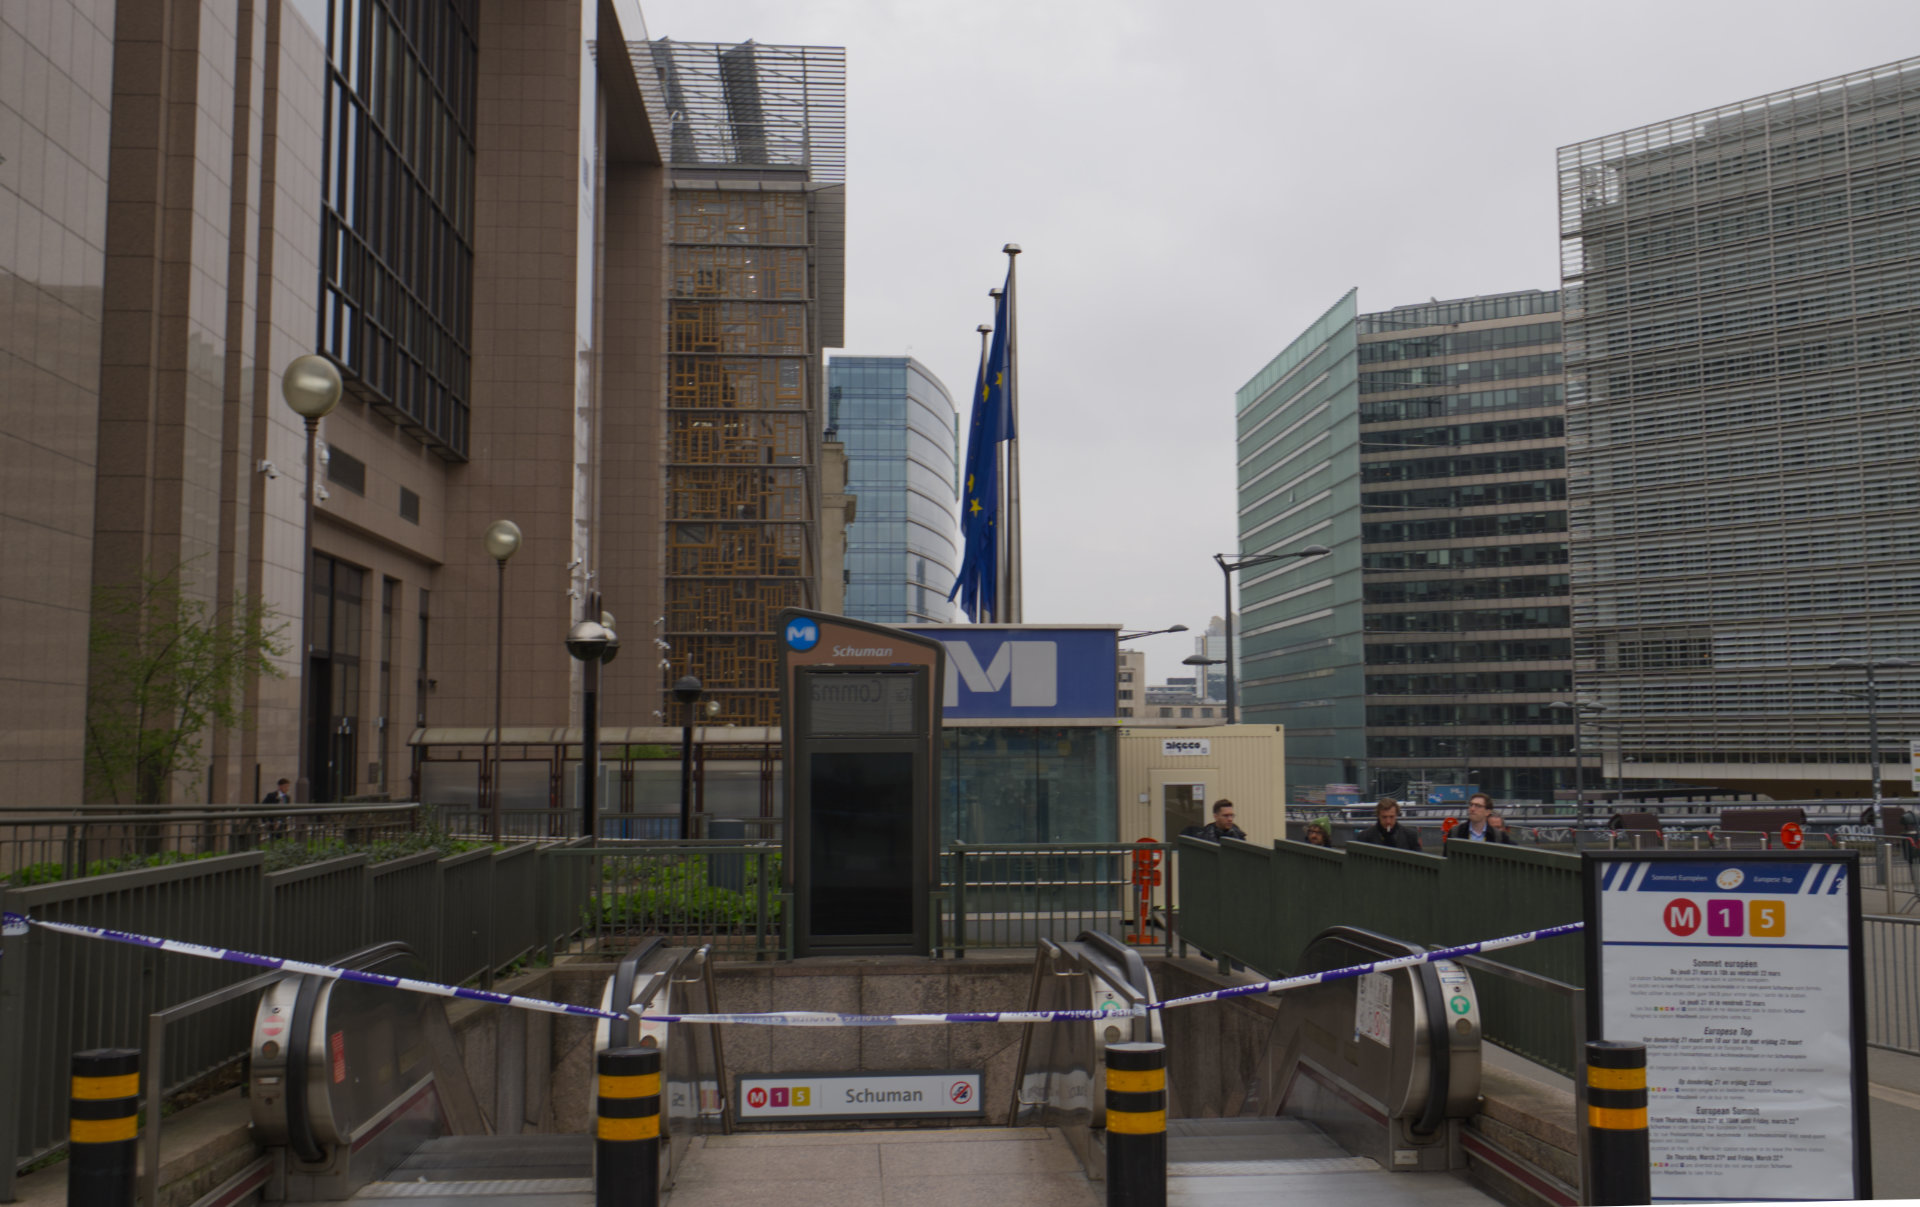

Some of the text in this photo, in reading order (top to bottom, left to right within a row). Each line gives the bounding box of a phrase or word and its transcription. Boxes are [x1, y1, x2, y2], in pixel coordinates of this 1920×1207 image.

[832, 644, 894, 658] Schuman
[1651, 873, 1708, 883] Sommet Européen
[1753, 876, 1793, 885] Europese Top
[1670, 906, 1775, 929] M 1 5
[1692, 958, 1758, 969] Sommet européen
[1704, 1026, 1753, 1037] Europese Top
[750, 1087, 923, 1104] M 1 5 Schuman
[1696, 1106, 1760, 1116] European Summit
